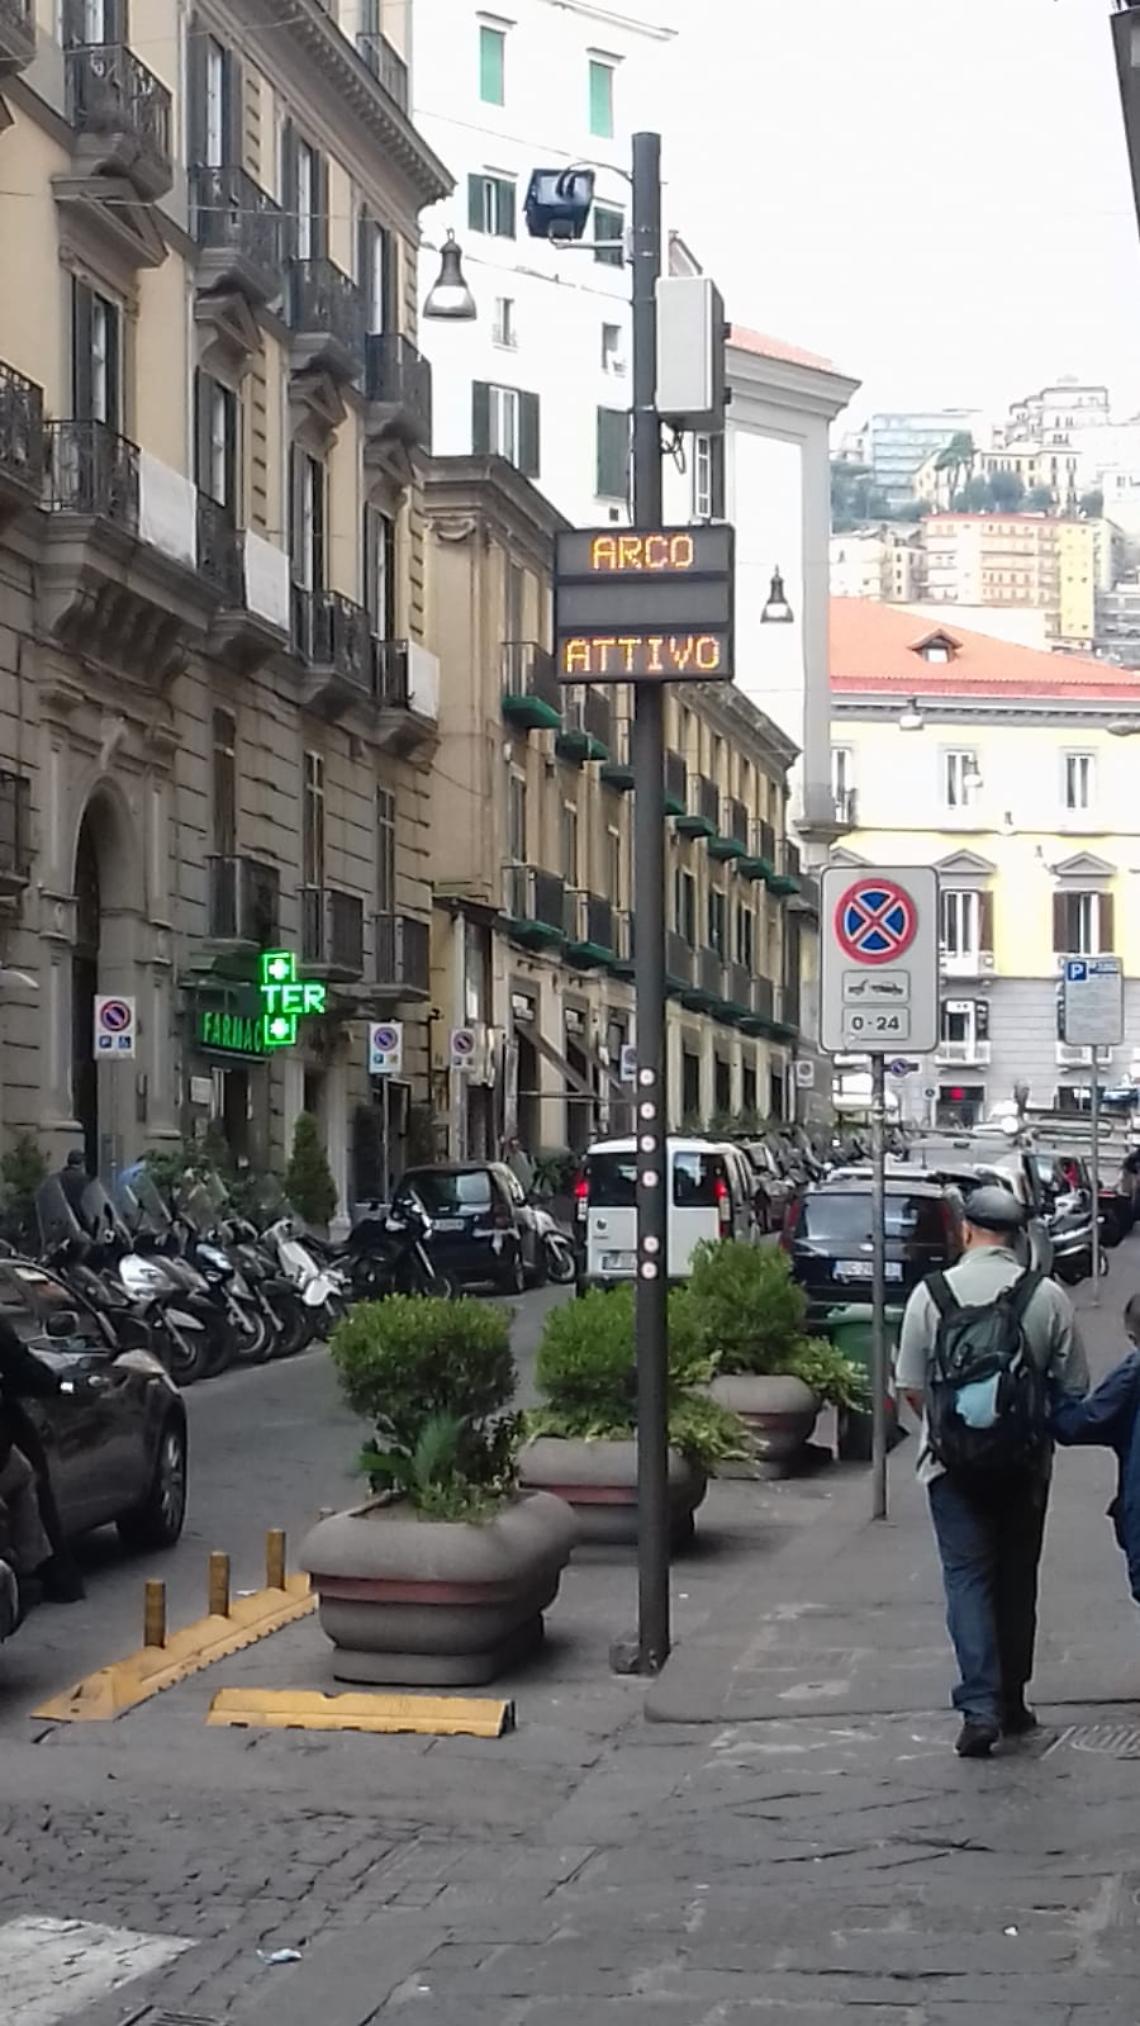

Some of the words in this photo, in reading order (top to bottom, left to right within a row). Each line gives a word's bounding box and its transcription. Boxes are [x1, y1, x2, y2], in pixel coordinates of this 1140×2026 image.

[591, 535, 694, 569] ARCO
[565, 636, 720, 673] ATTIVO
[260, 984, 325, 1013] TER
[203, 1012, 274, 1055] FARMAC
